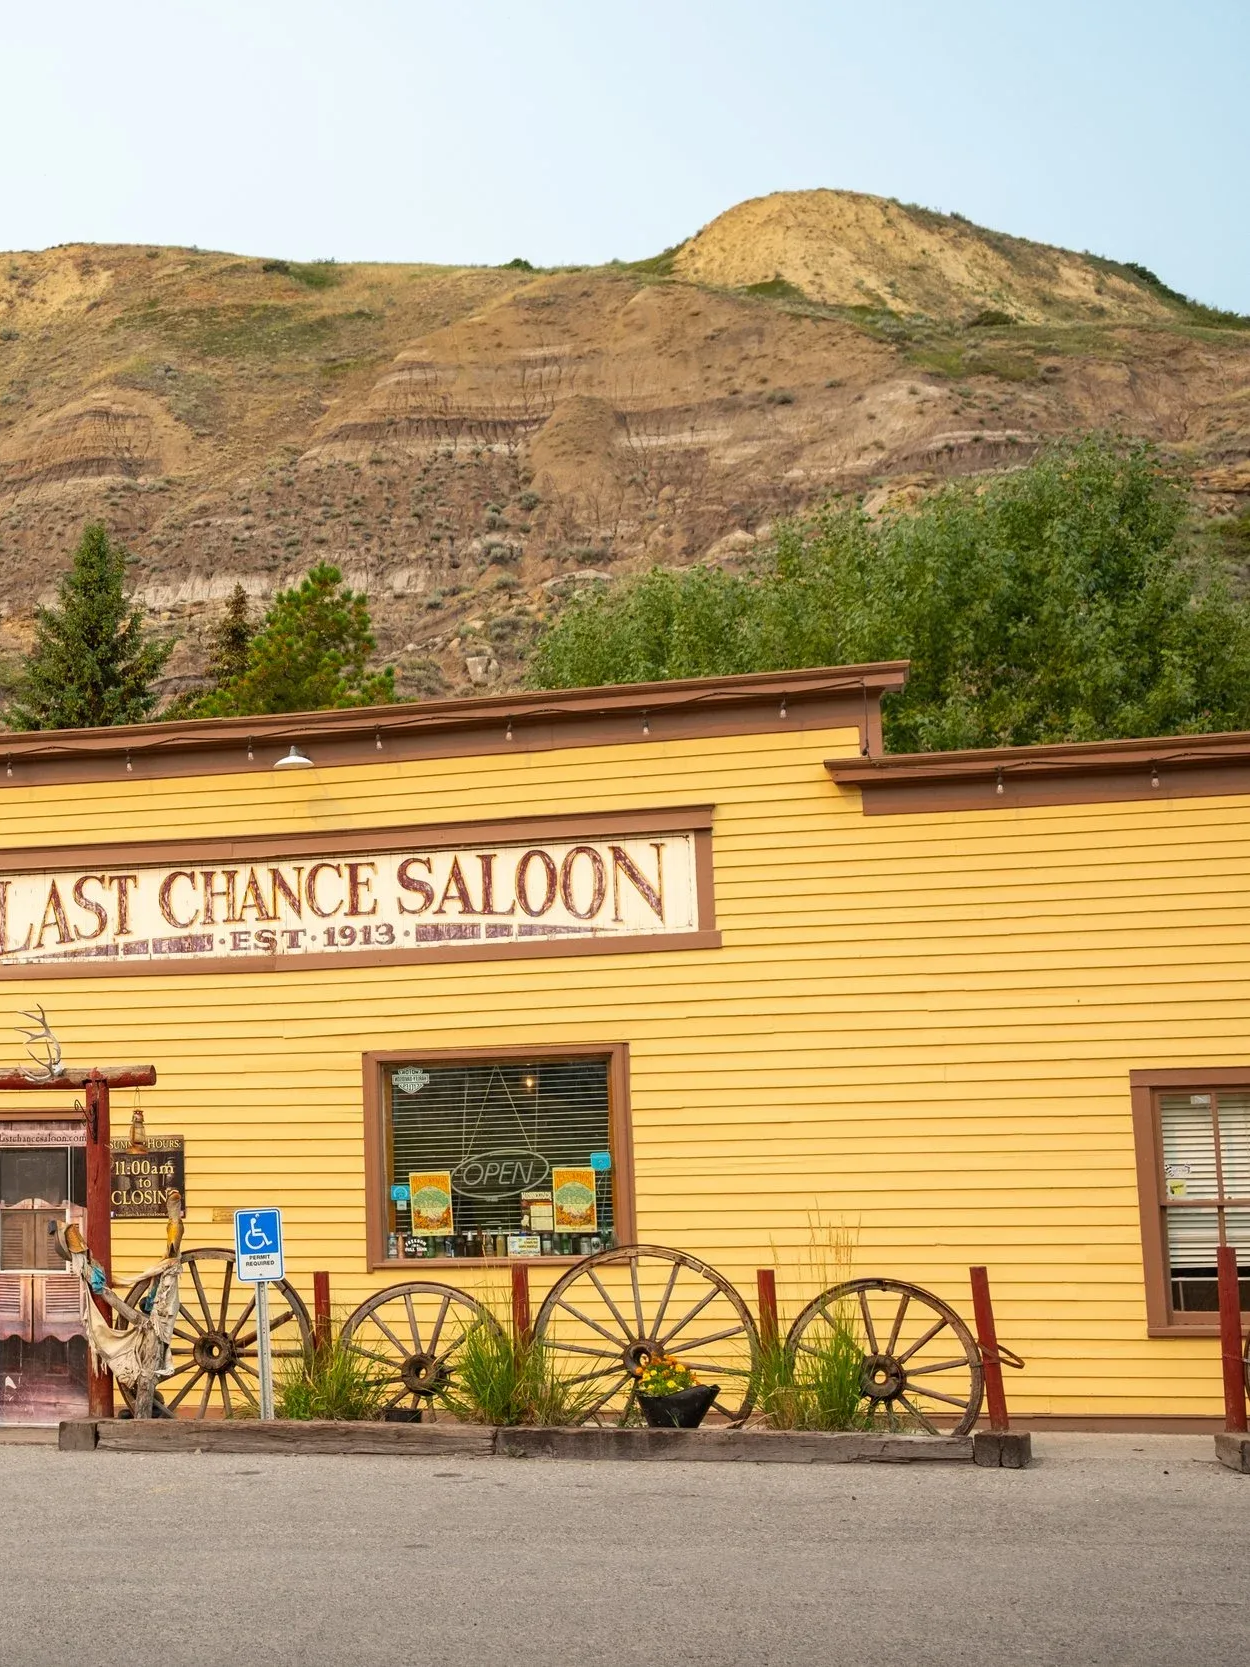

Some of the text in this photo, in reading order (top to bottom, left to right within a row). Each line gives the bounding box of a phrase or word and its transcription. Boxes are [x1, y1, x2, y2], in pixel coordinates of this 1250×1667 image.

[158, 861, 378, 929] CHANCE
[396, 843, 667, 925] SALOON
[323, 923, 396, 946] 1913
[115, 1160, 174, 1176] 11:00am
[463, 1161, 534, 1185] OPEN
[139, 1178, 151, 1188] to
[111, 1190, 169, 1205] CLOSIN
